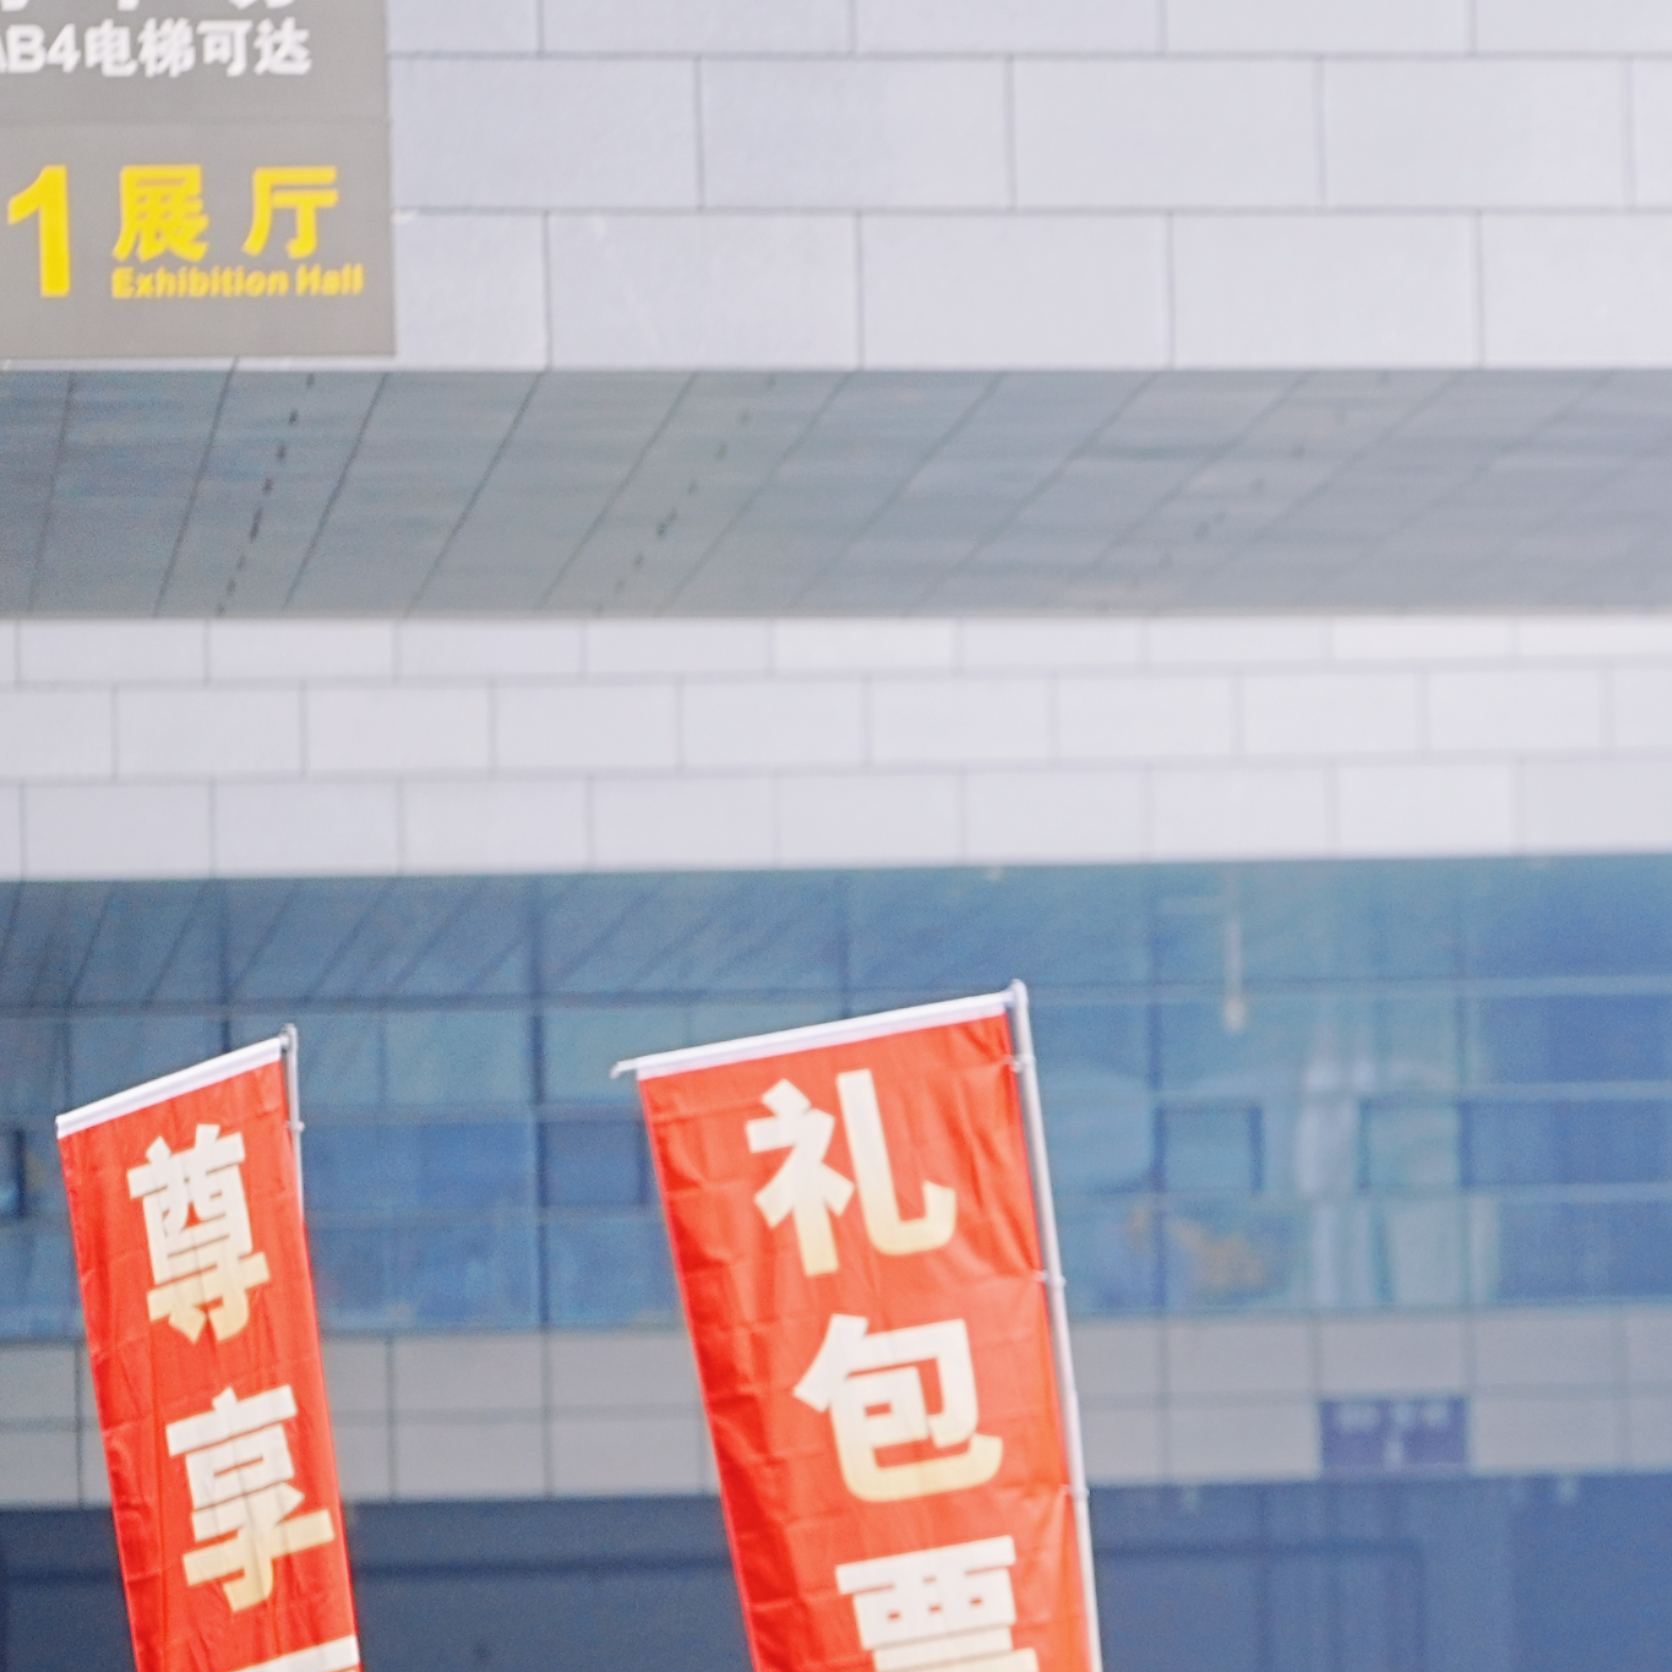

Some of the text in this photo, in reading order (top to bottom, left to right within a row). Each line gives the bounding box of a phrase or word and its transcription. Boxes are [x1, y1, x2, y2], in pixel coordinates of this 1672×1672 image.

[0, 17, 312, 77] B4电梯可达
[8, 164, 338, 298] 1 展厅
[112, 263, 364, 299] Exhibition Hall
